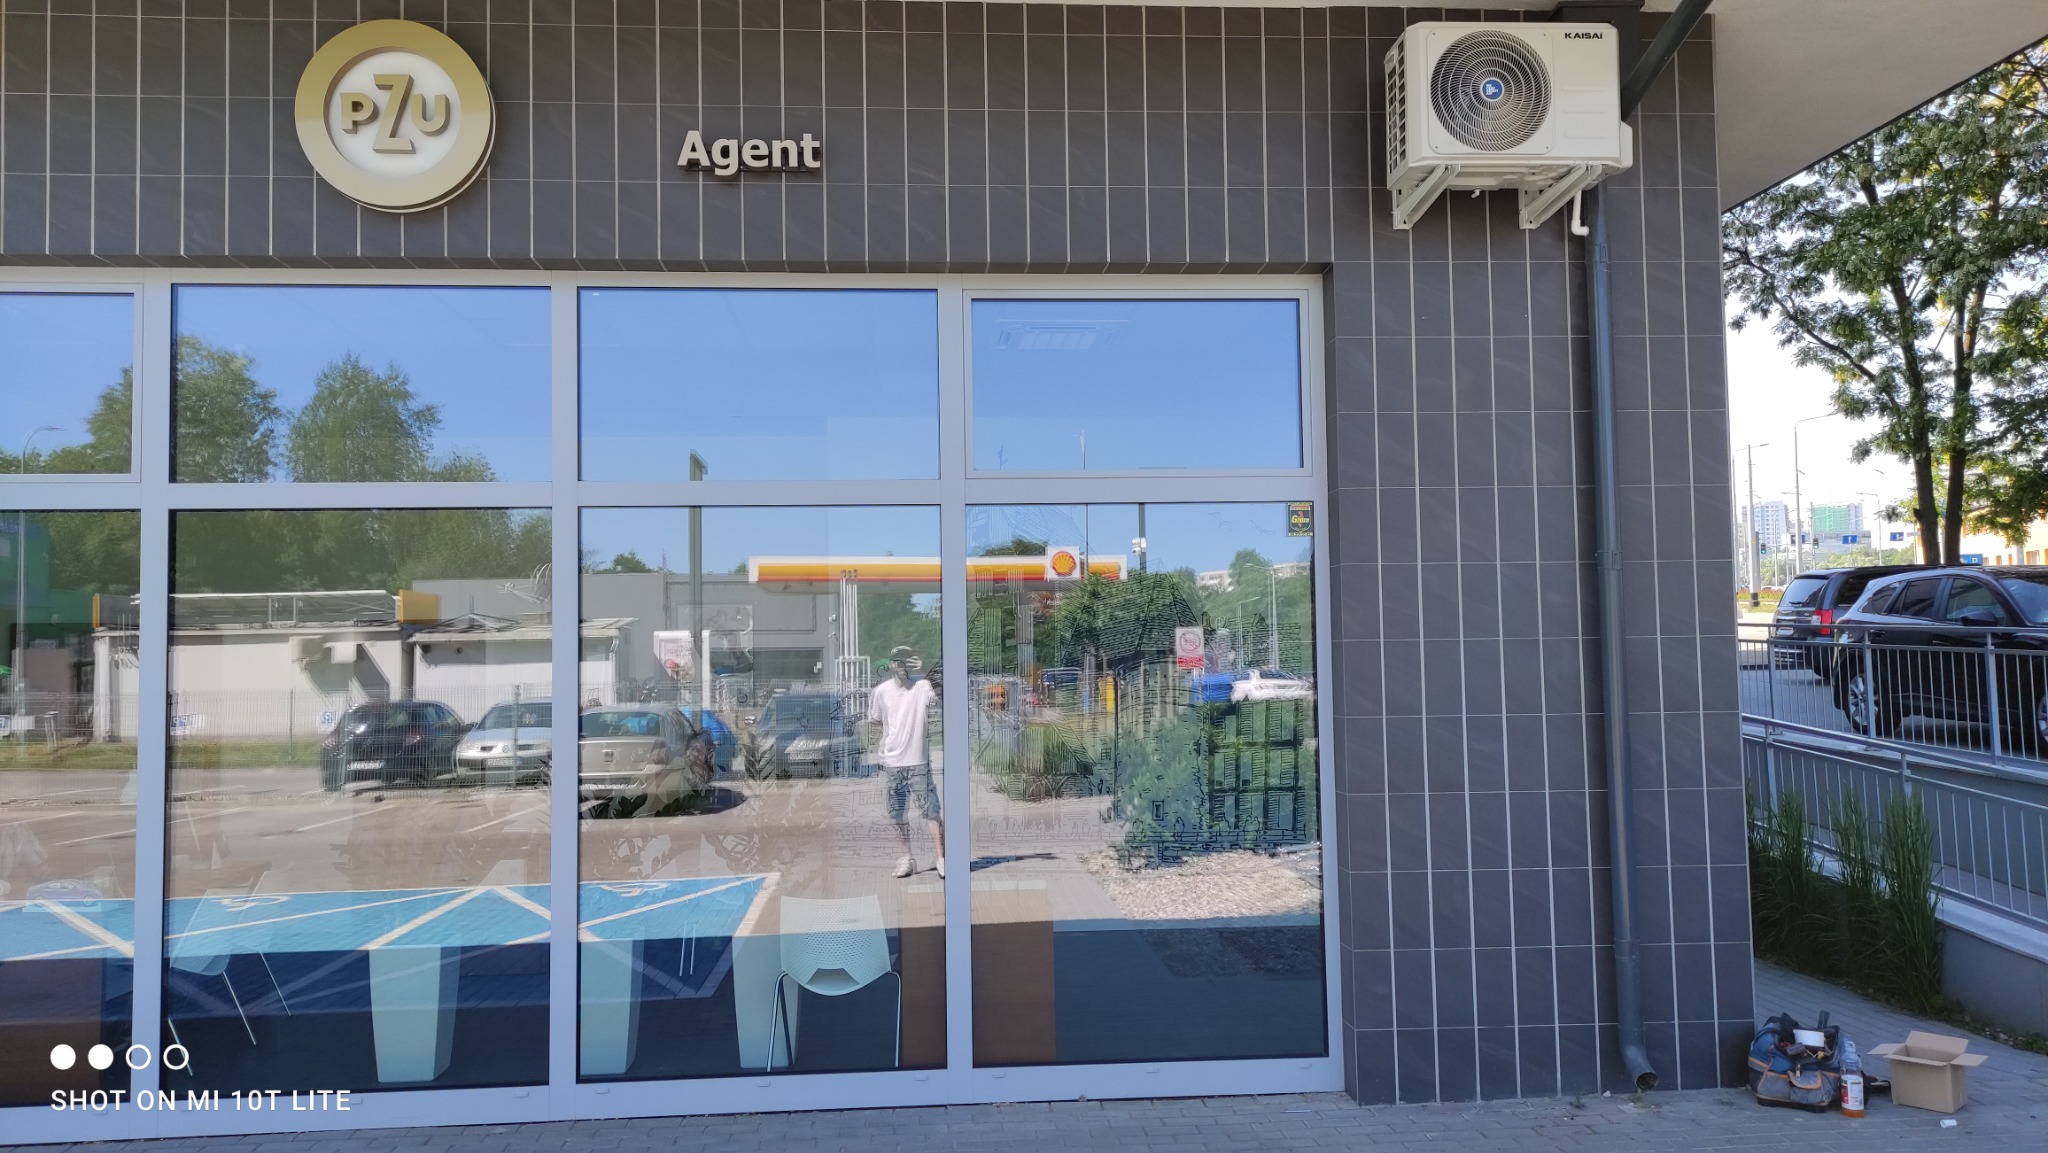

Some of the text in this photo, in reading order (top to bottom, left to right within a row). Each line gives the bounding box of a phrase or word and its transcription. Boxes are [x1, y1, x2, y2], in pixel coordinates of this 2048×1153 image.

[1564, 32, 1603, 40] KAISAI
[340, 73, 451, 154] PZU
[677, 130, 821, 177] Agent
